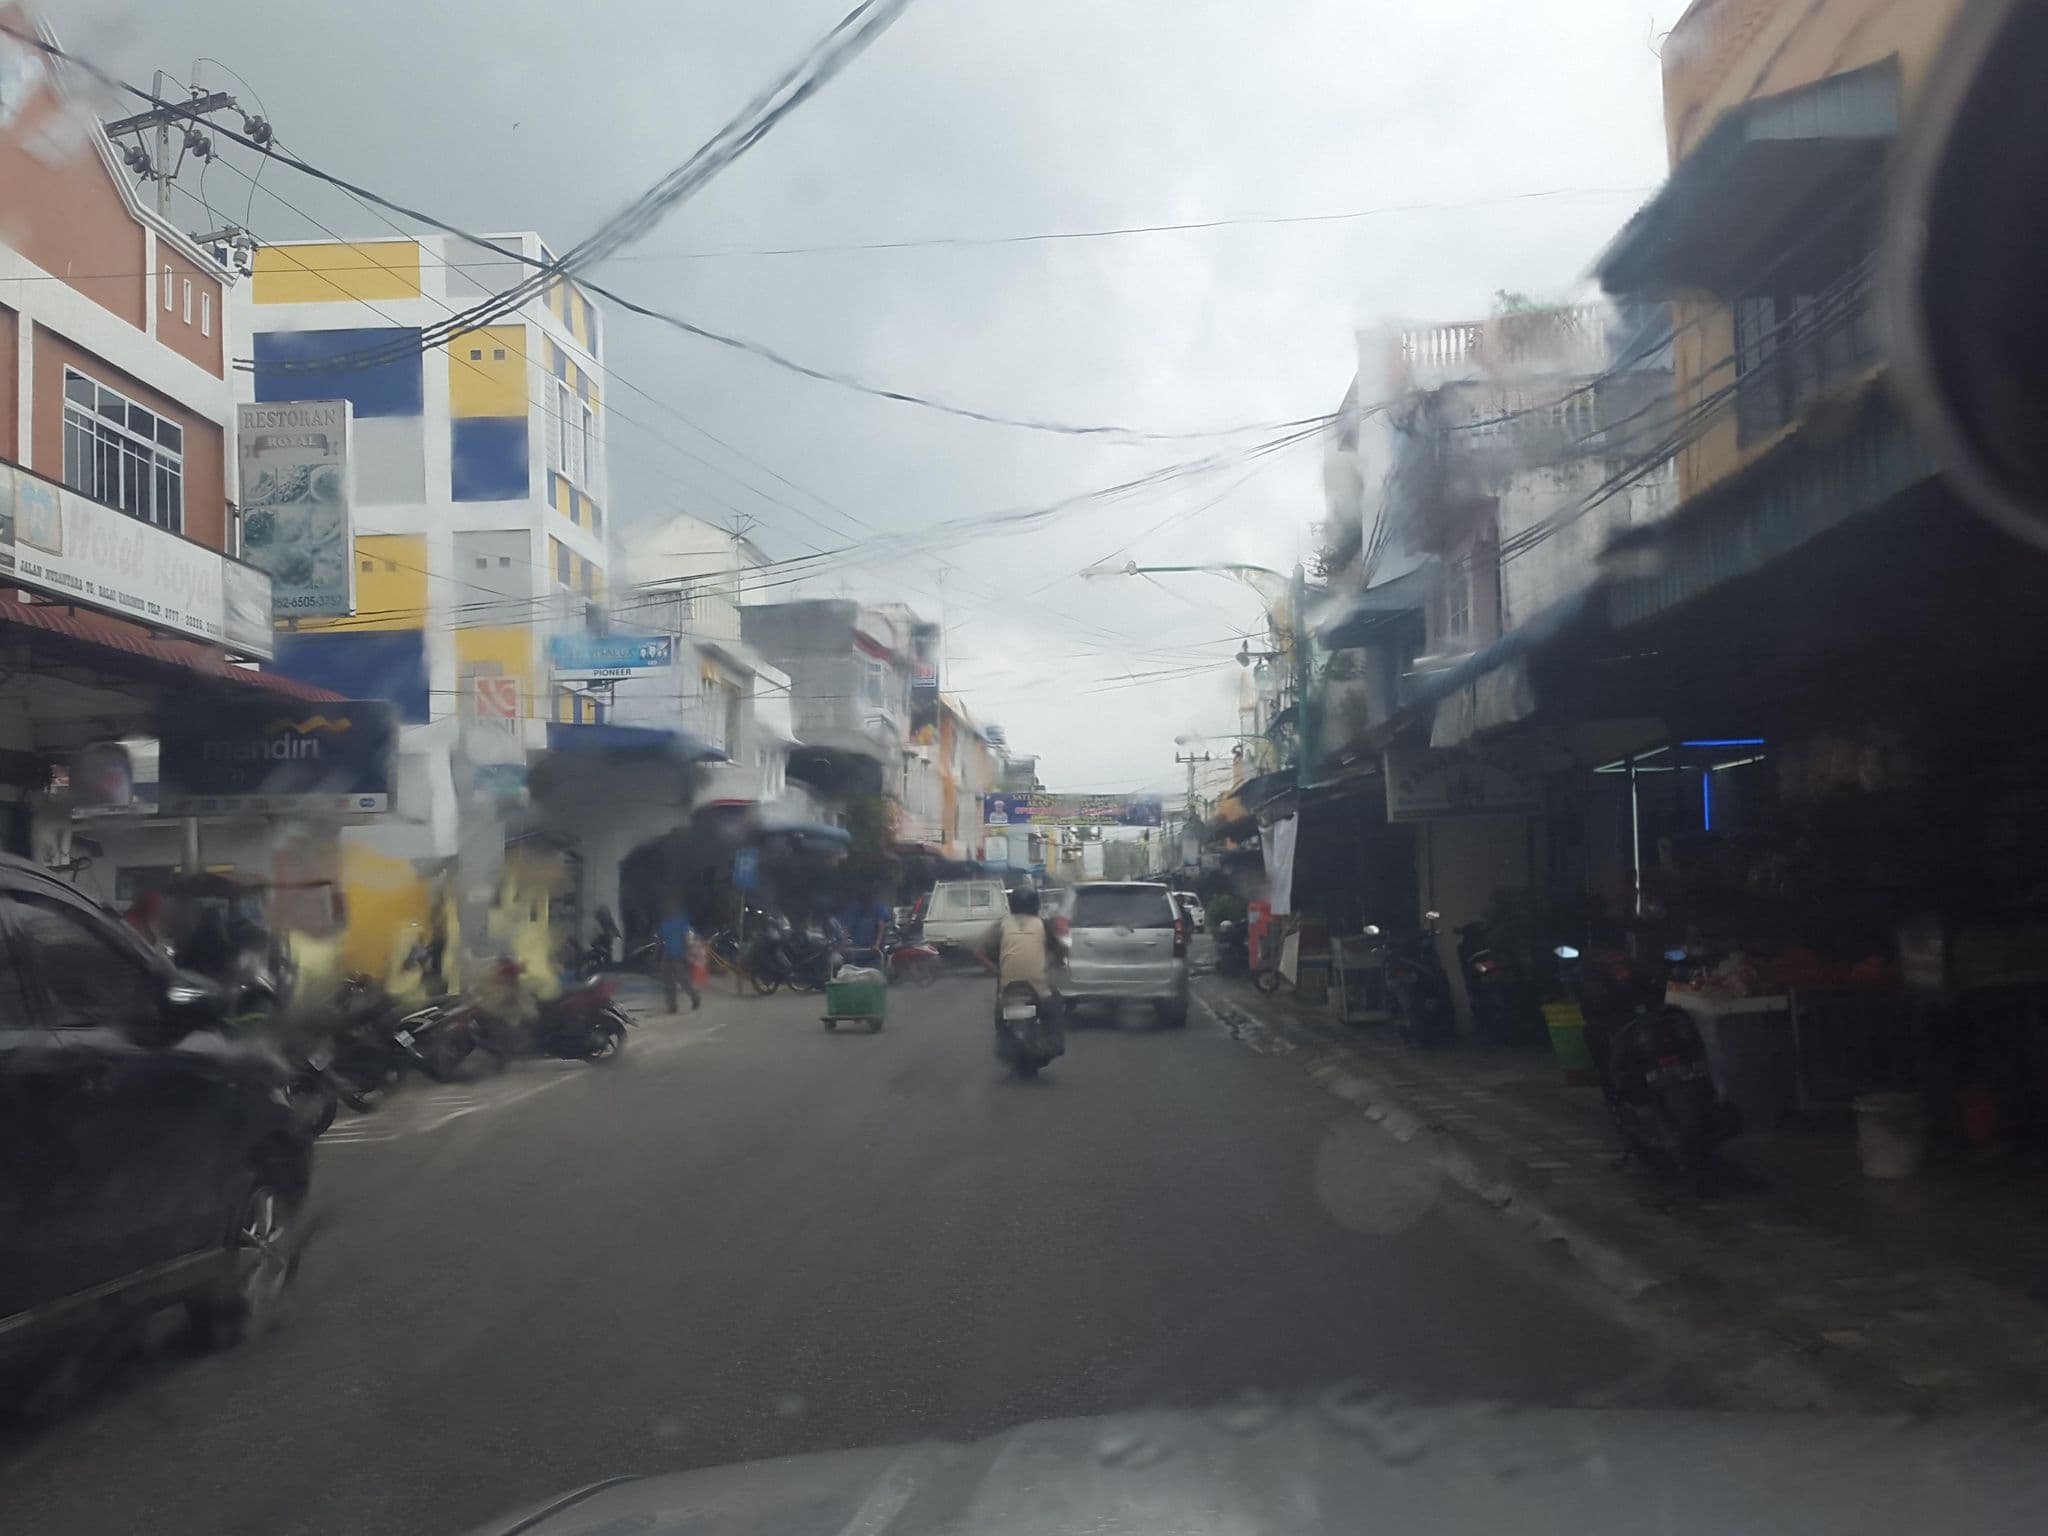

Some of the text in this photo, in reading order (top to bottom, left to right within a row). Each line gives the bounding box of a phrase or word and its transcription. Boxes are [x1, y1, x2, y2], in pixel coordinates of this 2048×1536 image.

[243, 408, 336, 429] RESTORAN
[267, 435, 318, 449] ROYAL
[20, 560, 42, 578] JALAN
[594, 668, 632, 677] PIONEER
[203, 732, 320, 761] mandiri
